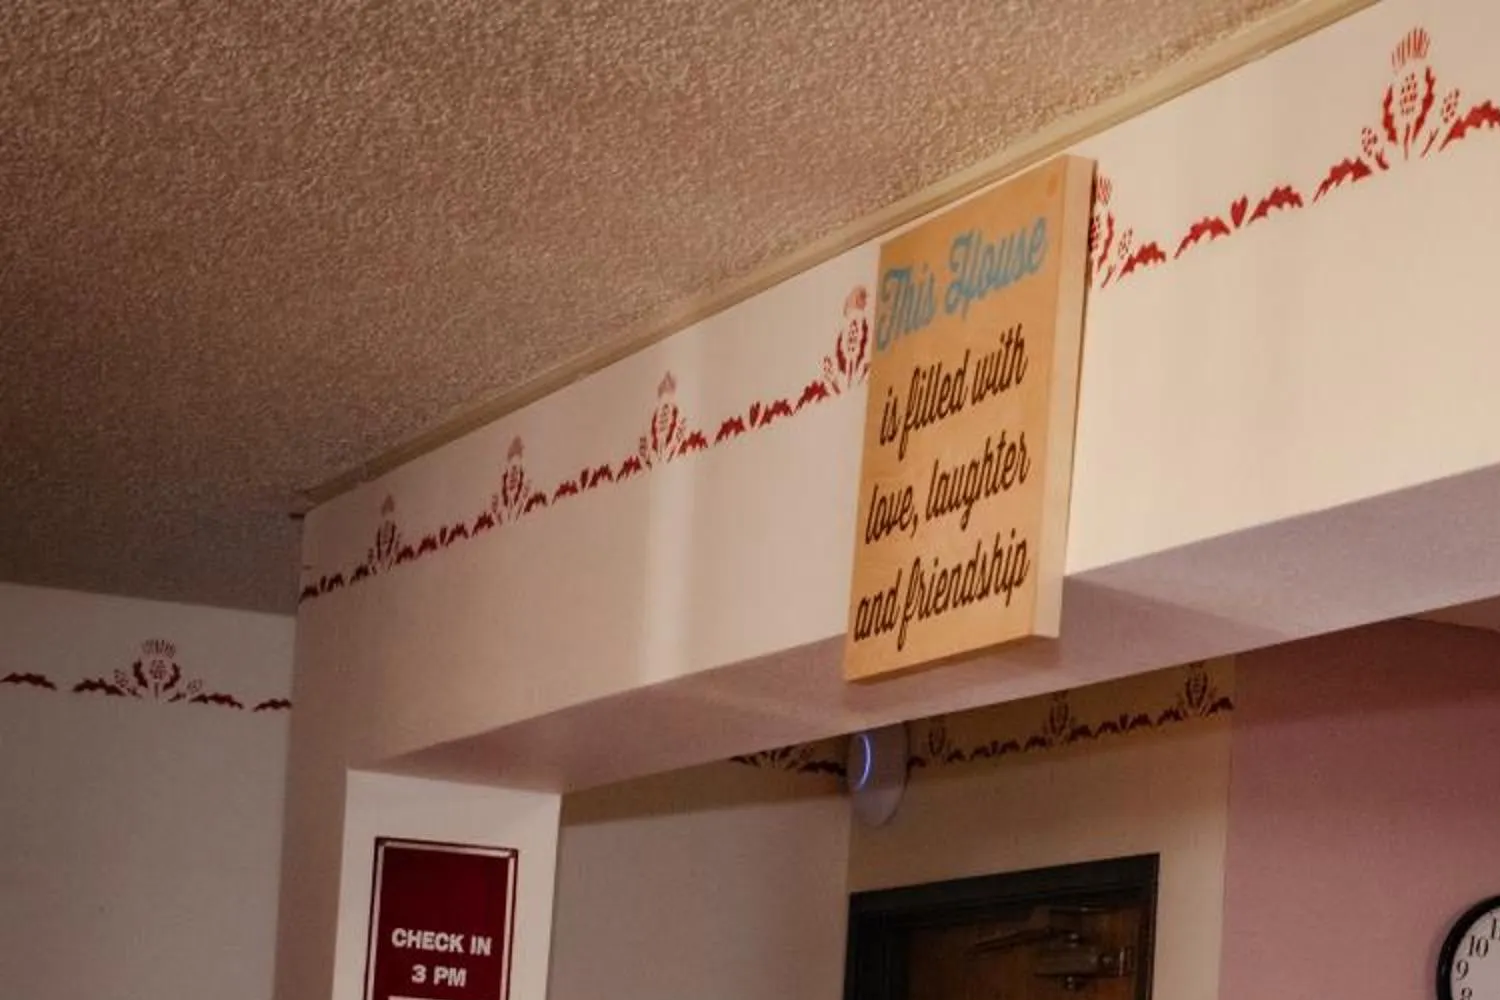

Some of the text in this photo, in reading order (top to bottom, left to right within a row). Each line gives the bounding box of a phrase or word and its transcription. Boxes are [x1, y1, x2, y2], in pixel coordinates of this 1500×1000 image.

[876, 216, 1048, 352] This House
[879, 322, 1029, 461] is filled with
[865, 431, 1031, 545] love, laughter
[853, 528, 1031, 652] and friendship
[391, 927, 492, 956] CHECK IN
[411, 964, 468, 988] 3 PM
[1456, 959, 1469, 980] 9
[1468, 935, 1489, 959] 10
